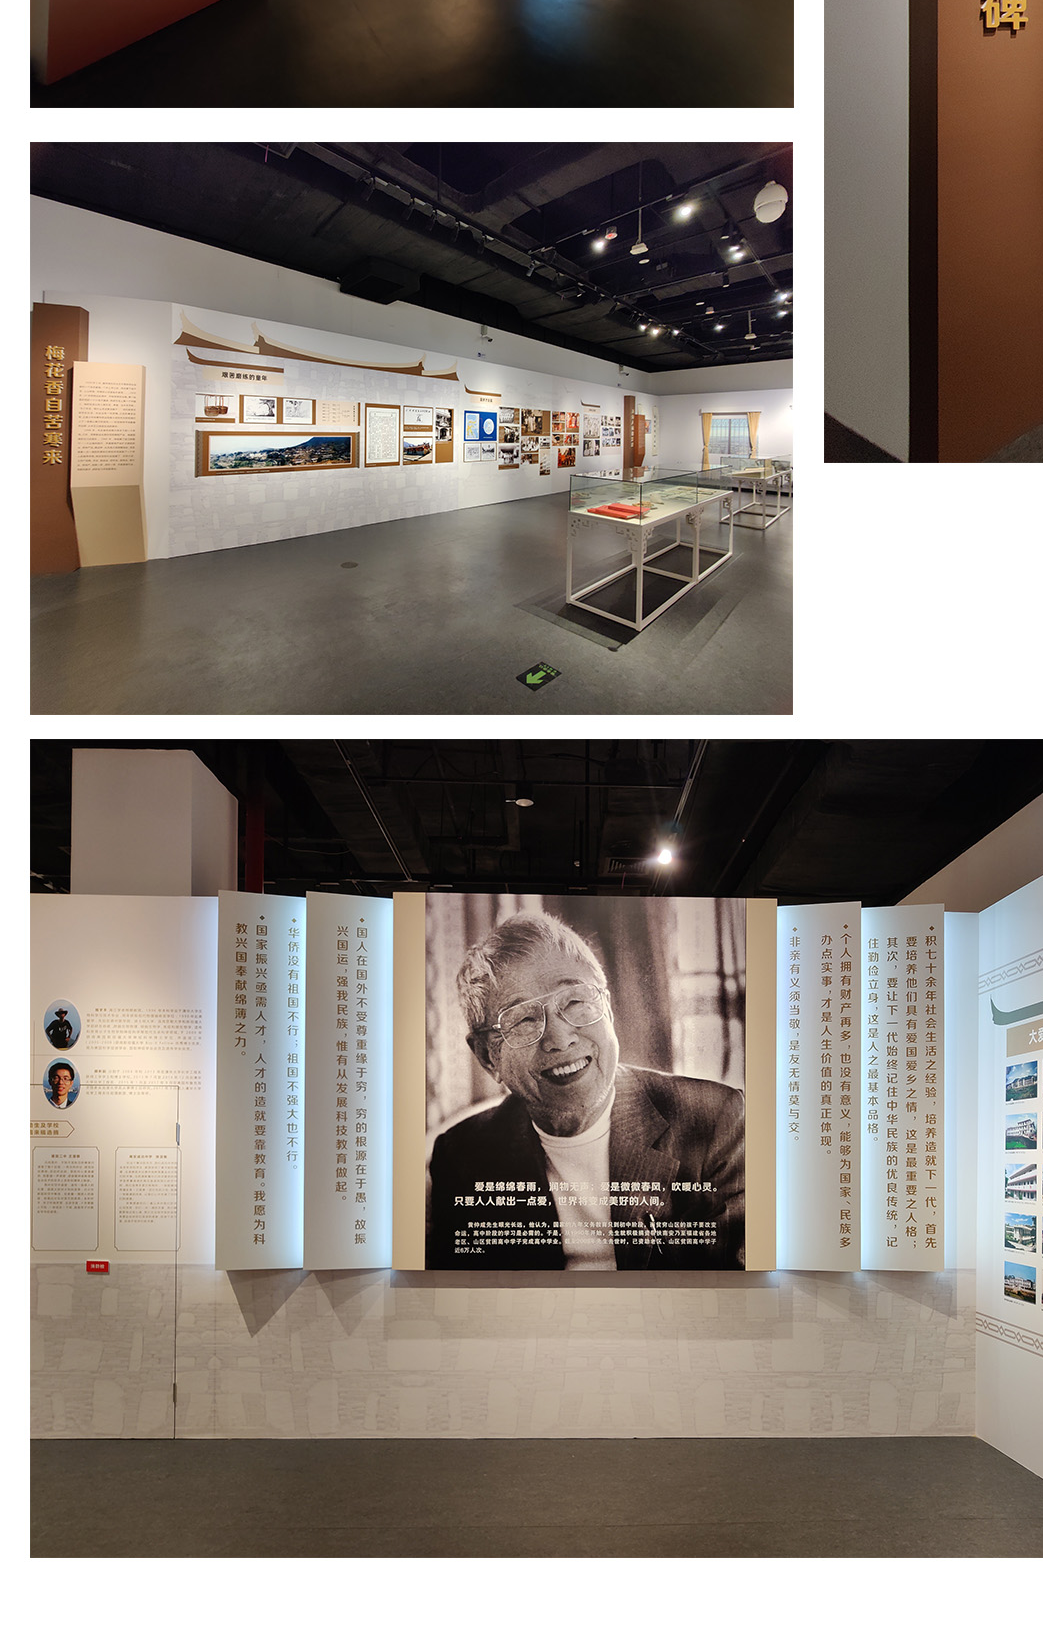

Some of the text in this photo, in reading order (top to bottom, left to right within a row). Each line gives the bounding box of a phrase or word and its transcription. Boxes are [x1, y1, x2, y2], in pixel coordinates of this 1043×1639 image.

[43, 344, 65, 466] 梅花香自苦寒来
[221, 370, 268, 382] 艰苦磨练的童年
[234, 922, 248, 1059] 教兴国奉献绵薄之力。
[253, 923, 269, 1247] 国家振兴亟需人才，人才的造就要靠教育。我愿为科
[285, 926, 301, 1171] 华侨没有祖国不行；祖国不强大也不行。
[334, 925, 349, 1202] 兴国运，强我民族，惟有从发展科技教育做起。
[353, 926, 369, 1246] 国人在国外不受尊重缘于穷，穷的根源在于愚，故振
[788, 935, 801, 1143] 非亲有义须当敬，是友无情莫与交。
[819, 934, 833, 1156] 办点实事，才是人生价值的真正体现。
[838, 933, 852, 1249] 个人拥有财产再多，也没有意义，能够为国家、民族多
[866, 937, 880, 1144] 住勤俭立身，这是人之最基本品格。
[885, 936, 899, 1249] 其次，要让下一代始终记住中华民族的优良传统，记
[904, 936, 919, 1250] 要培养他们具有爱国爱乡之情，这是最重要之人格；
[924, 935, 938, 1249] 积七十余年社会生活之经验，培养造就下一代，首先
[454, 1196, 665, 1207] 只要人人献出一点爱，世界将变成美好的人间。
[474, 1181, 718, 1192] 爱是绵绵春雨，润物无声；爱是微微春风，吹暖心灵。
